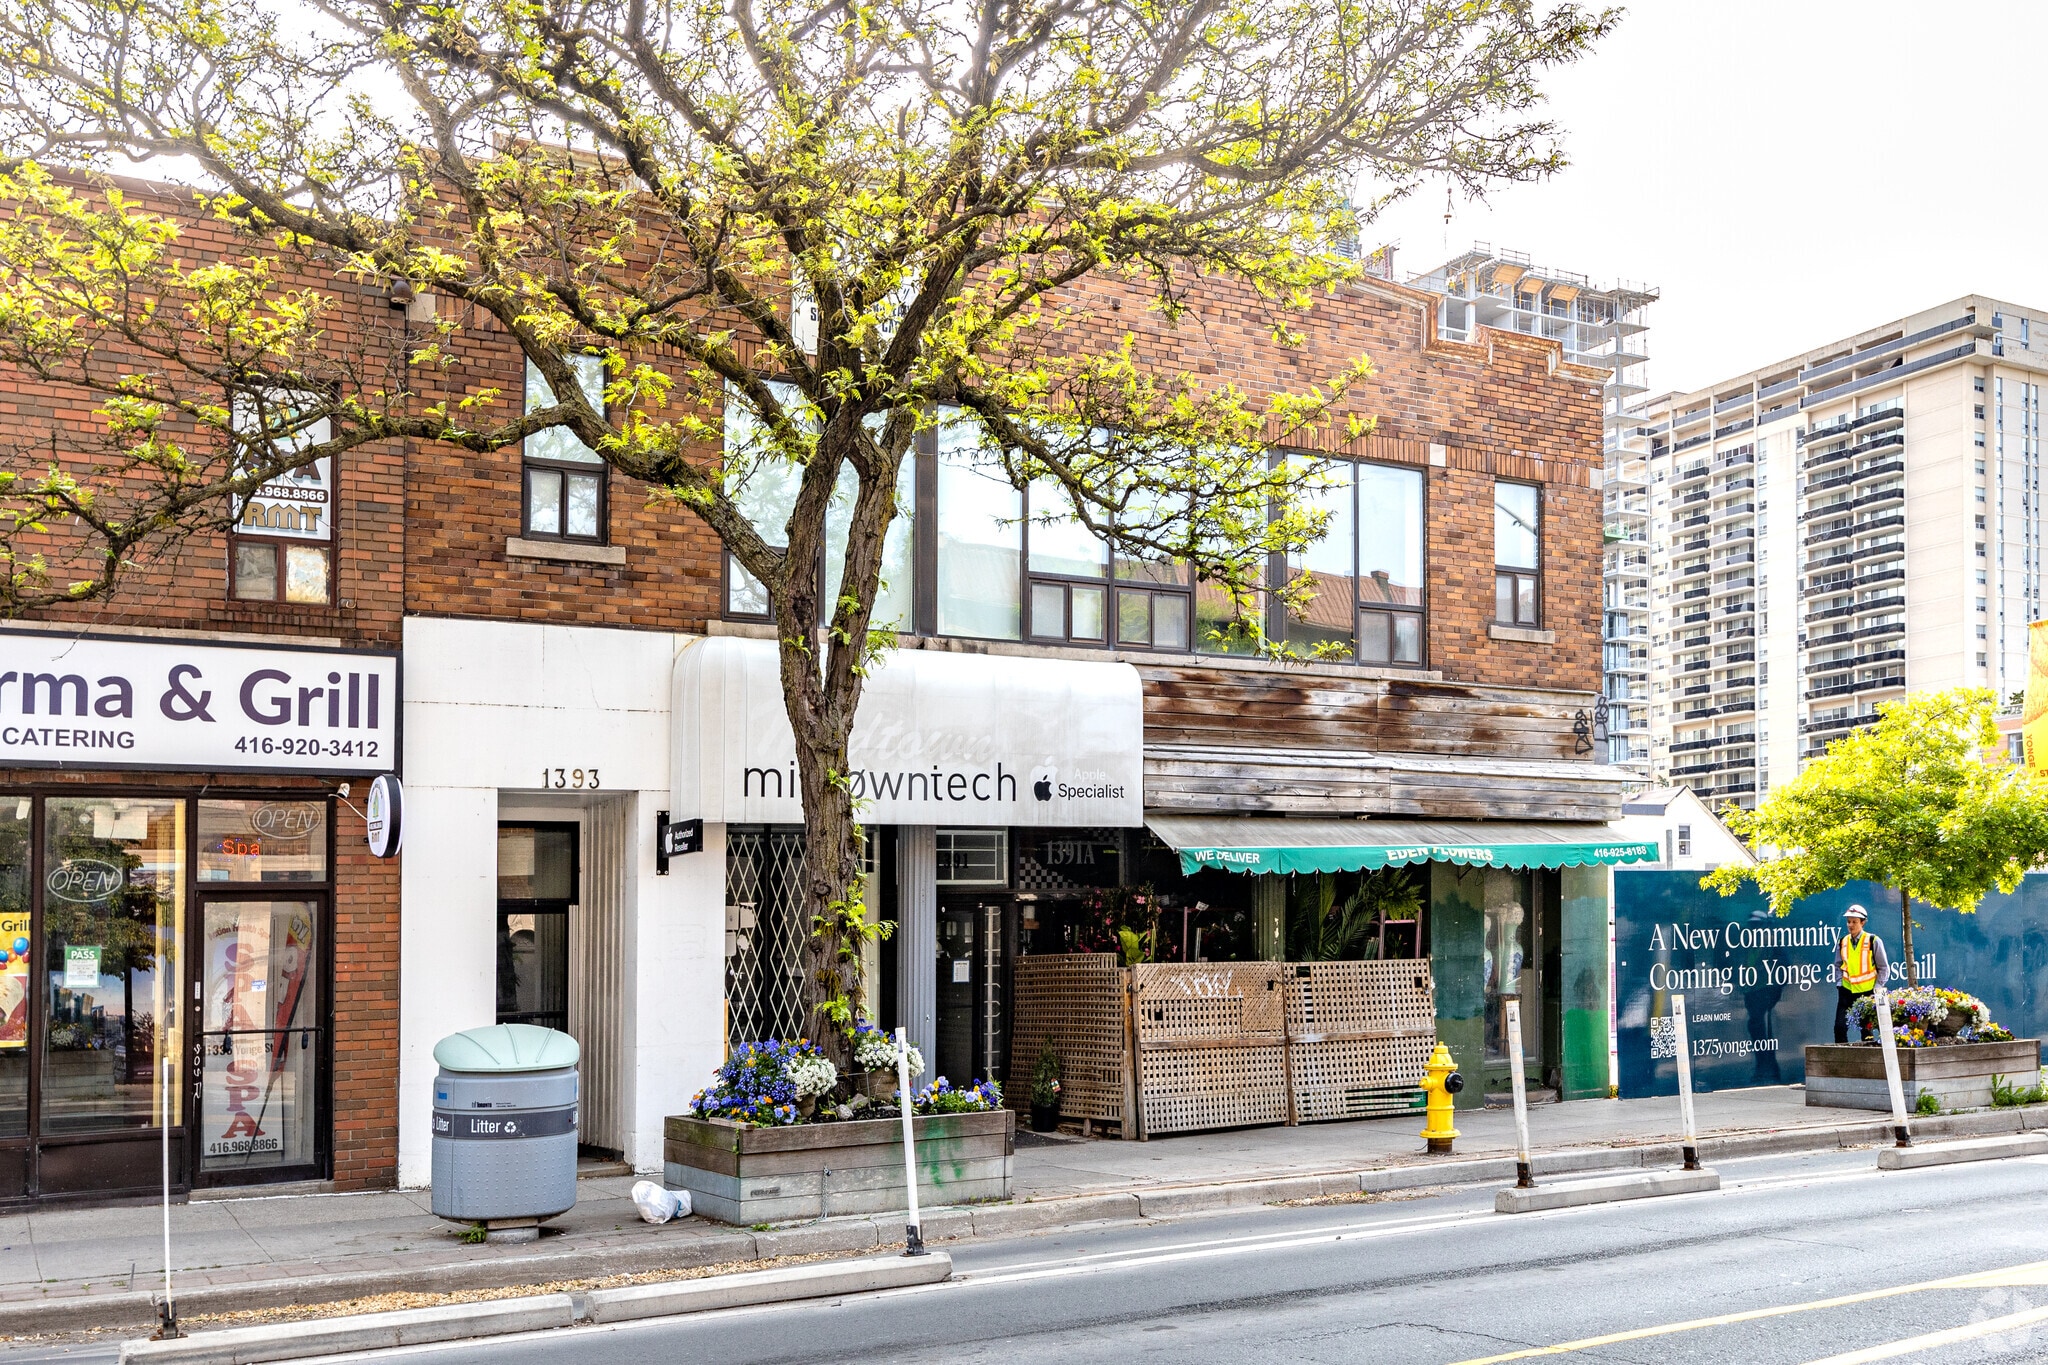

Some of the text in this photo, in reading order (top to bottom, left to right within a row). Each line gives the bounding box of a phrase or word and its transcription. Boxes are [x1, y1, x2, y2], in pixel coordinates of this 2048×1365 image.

[242, 502, 322, 532] RMT
[159, 664, 217, 723] &
[239, 669, 380, 729] Grill
[2, 727, 379, 758] CATERING 416-920-3412
[2026, 734, 2036, 768] YONGE
[542, 768, 600, 789] 1393
[1058, 783, 1125, 801] Specialist
[256, 808, 315, 829] OPEN
[222, 839, 260, 861] Spa
[1046, 840, 1096, 865] 1391A
[1194, 849, 1260, 864] WE DELIVER
[1385, 846, 1494, 862] EDEN FLOWERS
[51, 870, 116, 891] OPEN
[1648, 920, 1842, 953] A New Community
[71, 950, 95, 960] PASS
[1649, 961, 1734, 995] Coming
[1738, 963, 1758, 987] to
[1761, 958, 1822, 992] Yonge
[1692, 1012, 1732, 1023] LEARN MORE
[1692, 1038, 1779, 1059] 1375yonge.com
[221, 1059, 266, 1139] SPA
[436, 1116, 450, 1132] Litter
[470, 1118, 502, 1133] Litter
